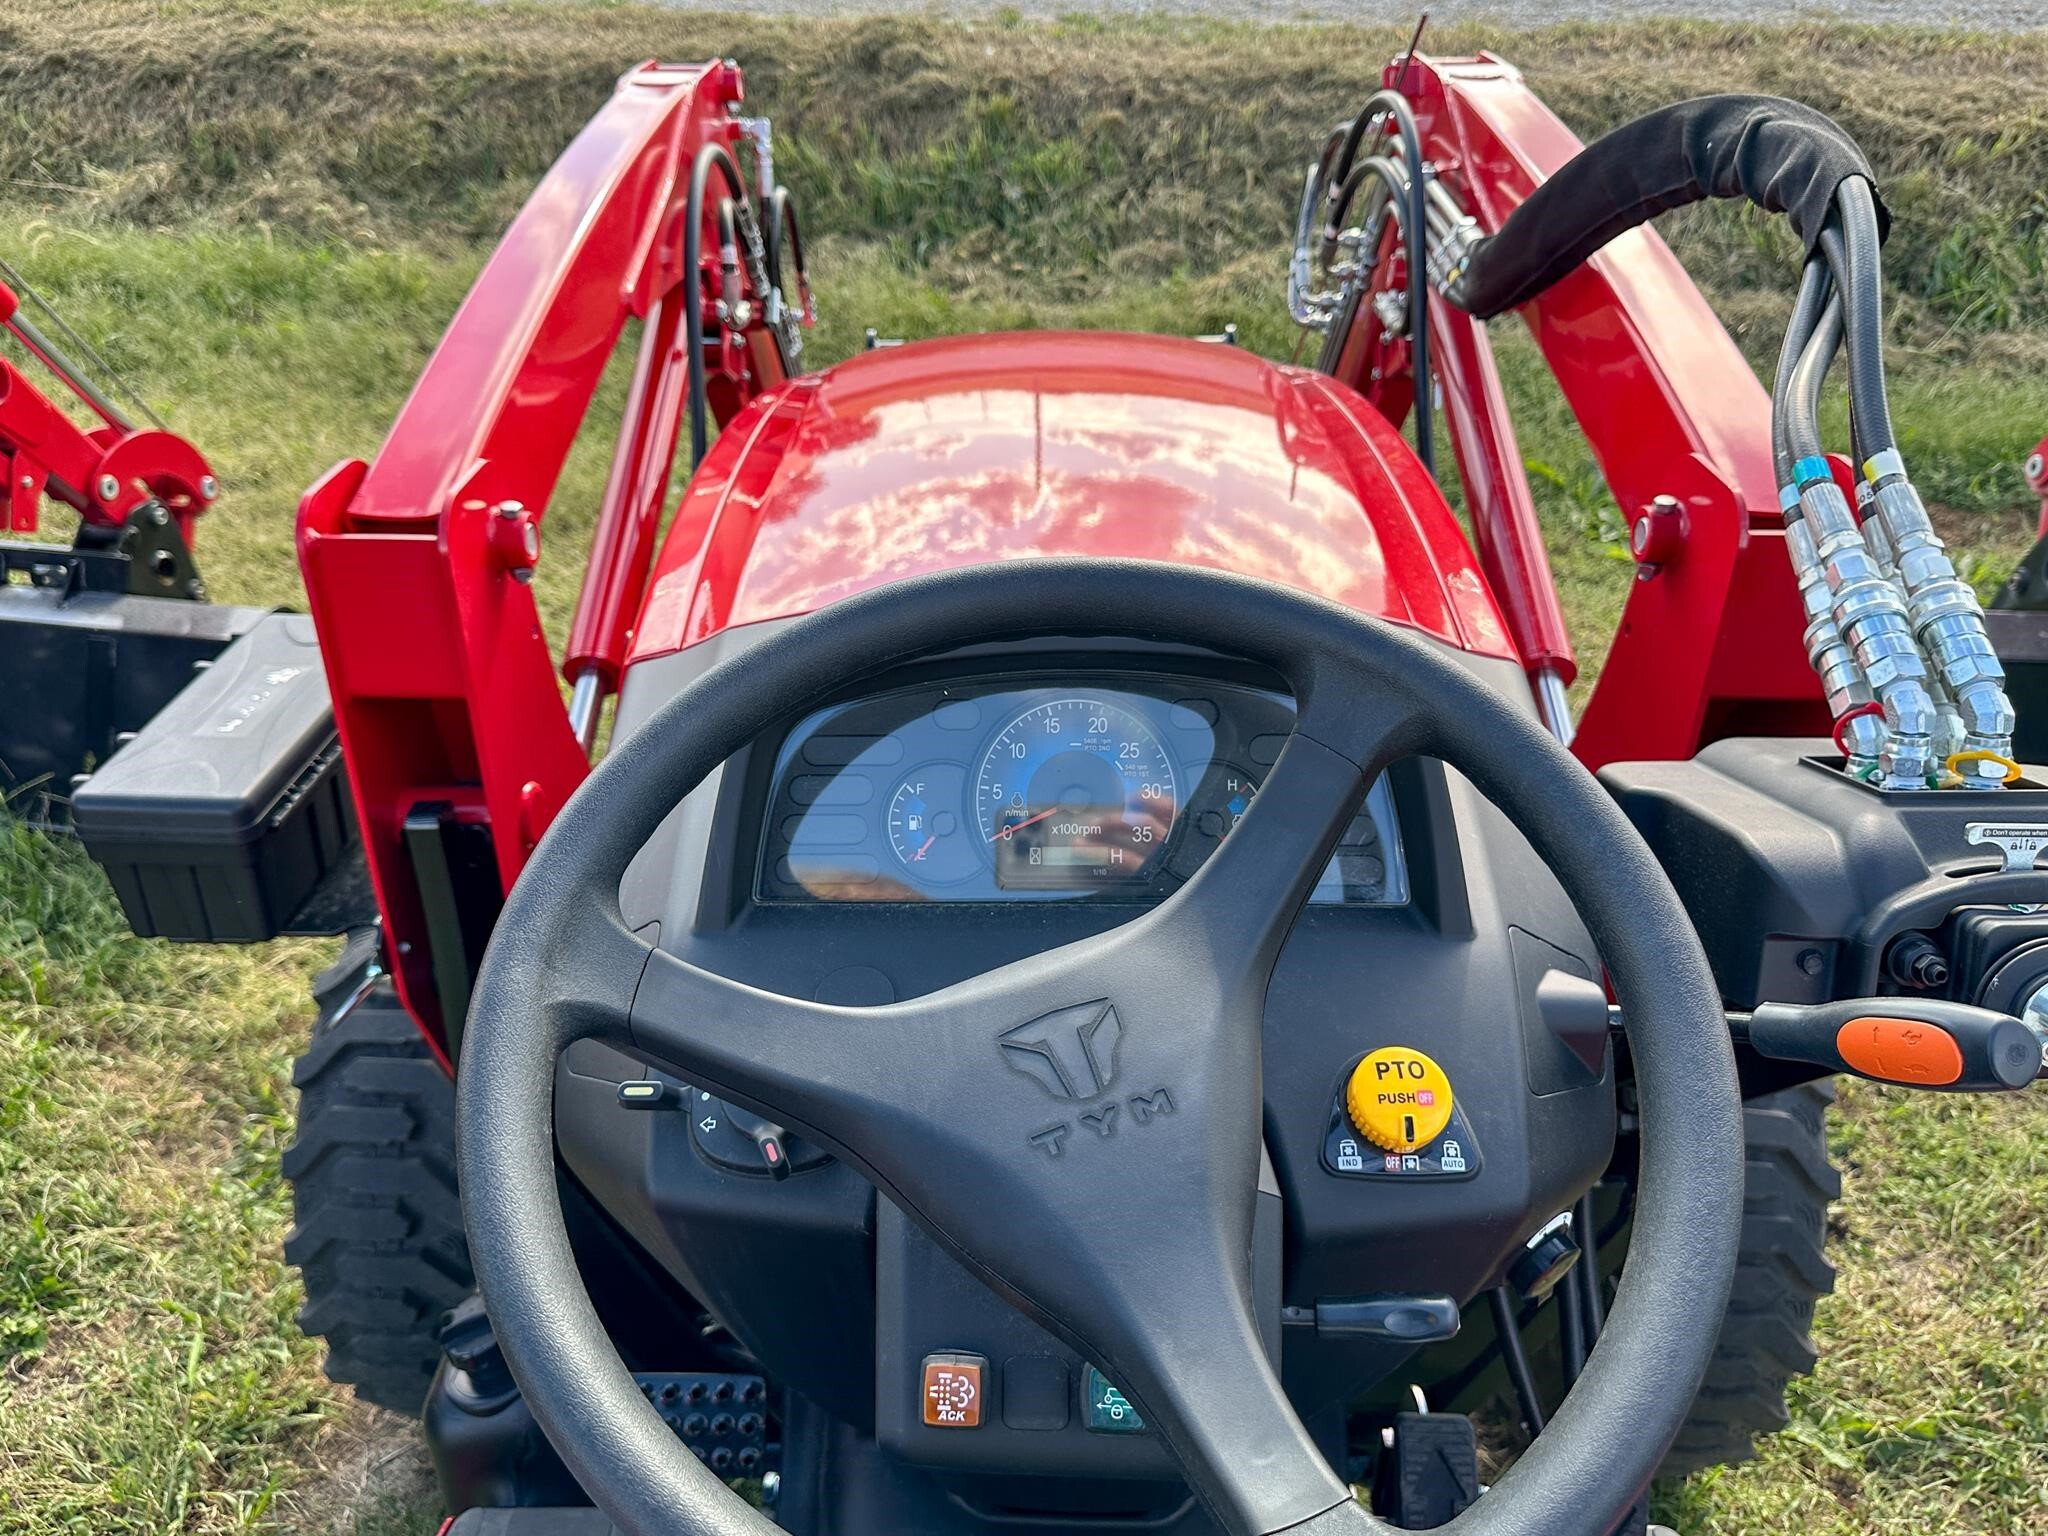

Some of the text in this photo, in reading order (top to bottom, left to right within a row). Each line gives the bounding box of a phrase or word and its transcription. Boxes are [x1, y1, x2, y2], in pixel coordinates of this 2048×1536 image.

[1043, 718, 1060, 734] 15
[1088, 717, 1108, 734] 20
[1008, 742, 1026, 759] 10
[1119, 742, 1140, 758] 25
[916, 783, 925, 795] F
[992, 783, 1003, 800] 5
[1141, 783, 1161, 799] 30
[1227, 779, 1238, 792] H
[1005, 808, 1029, 817] n/min
[1002, 824, 1013, 841] 0
[1051, 823, 1102, 836] x100rpm
[1131, 826, 1153, 843] 35
[1110, 848, 1123, 864] H
[1375, 1060, 1425, 1081] PTO
[1377, 1092, 1433, 1104] PUSH OFF
[1027, 1087, 1176, 1156] TYM
[1342, 1159, 1358, 1167] IND
[1385, 1156, 1400, 1169] OFF
[1443, 1160, 1464, 1169] AUTO
[937, 1410, 966, 1422] ACK
